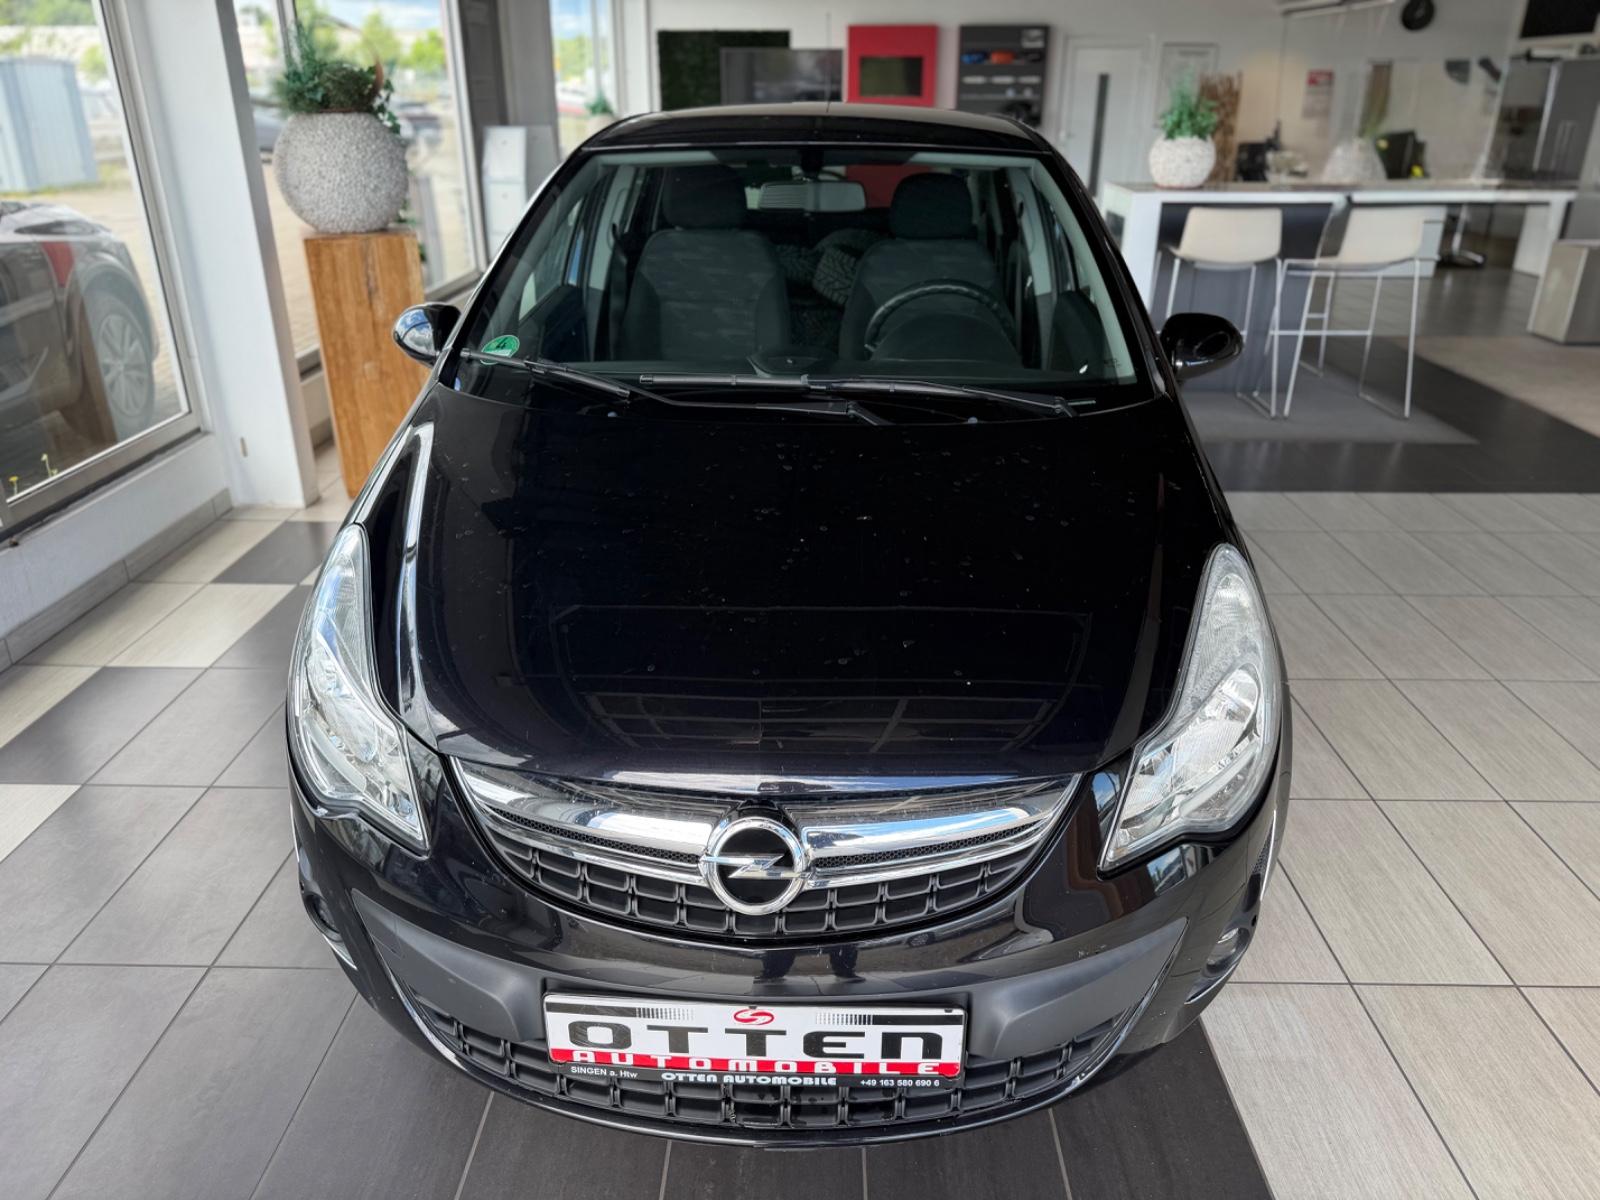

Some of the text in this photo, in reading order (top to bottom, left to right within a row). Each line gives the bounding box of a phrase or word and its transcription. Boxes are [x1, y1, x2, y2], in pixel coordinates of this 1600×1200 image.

[568, 1021, 942, 1059] OTTEN
[572, 1050, 940, 1075] AUTOMOBILE
[570, 1066, 607, 1076] SINGEN
[620, 1070, 638, 1078] Htw
[661, 1072, 837, 1086] OTTEN AUTOMOBILE
[860, 1079, 940, 1088] +49 163 580 690 6
